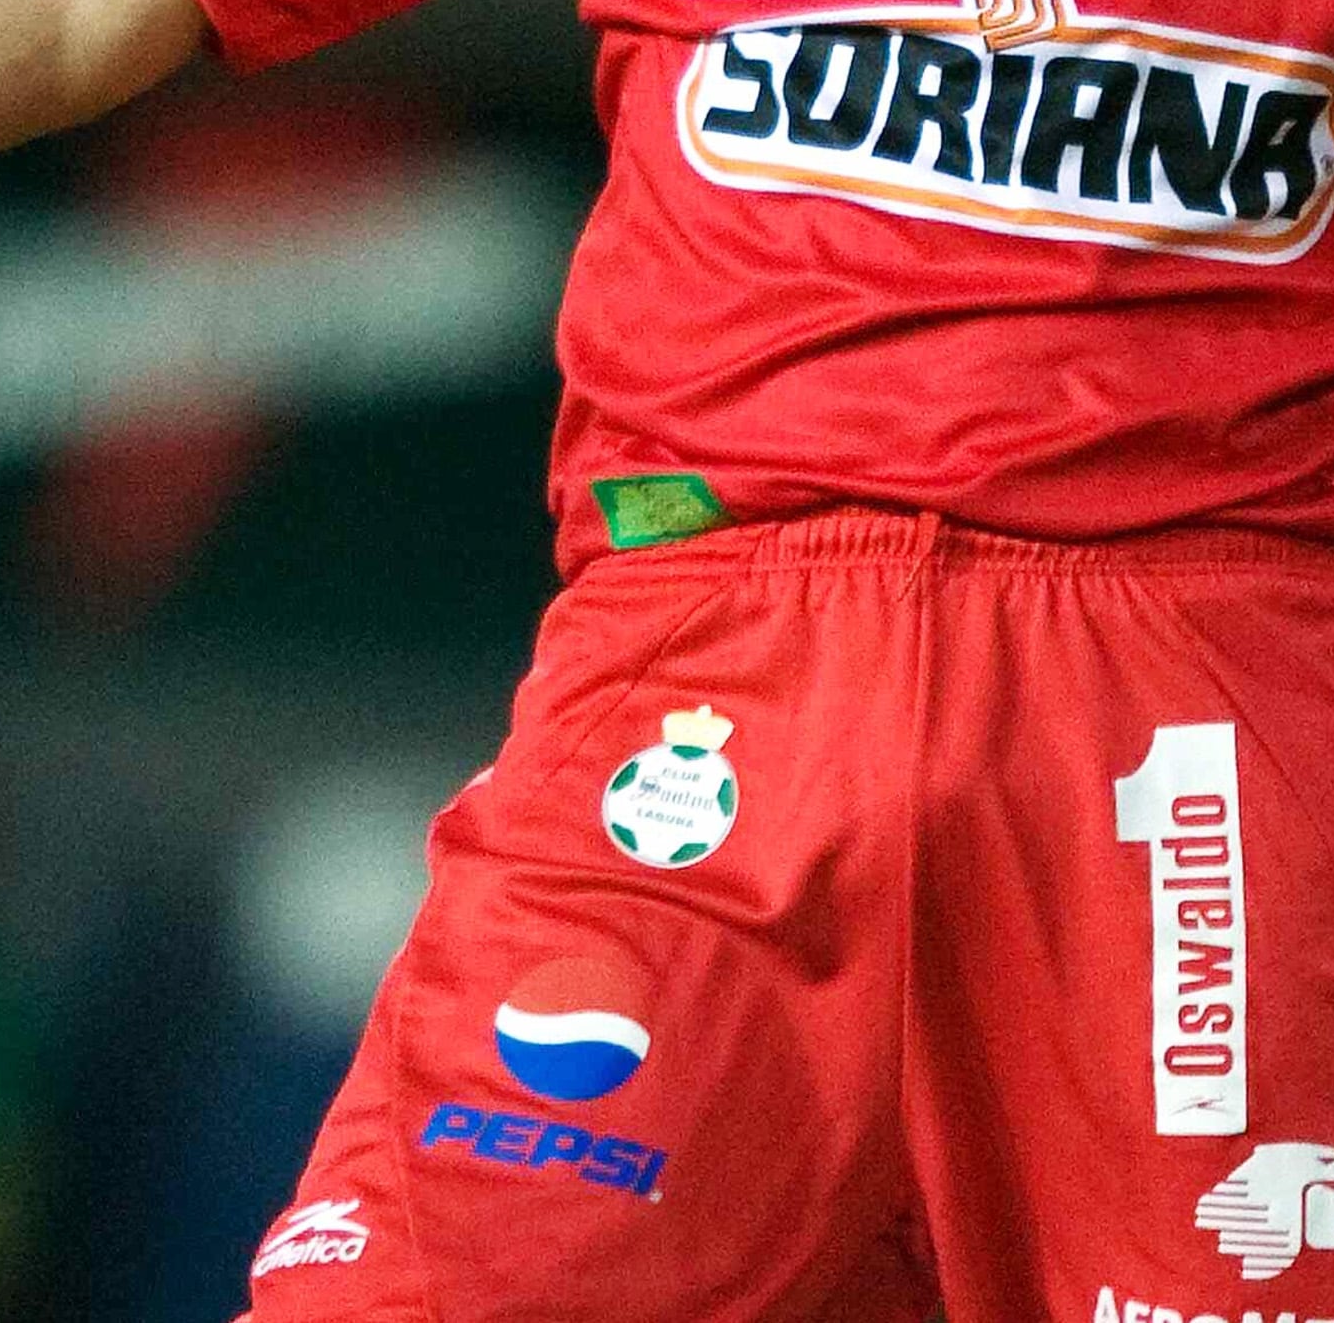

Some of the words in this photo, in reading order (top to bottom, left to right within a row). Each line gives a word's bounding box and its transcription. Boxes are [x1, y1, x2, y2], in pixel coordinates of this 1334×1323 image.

[702, 23, 1331, 222] SORIANA
[1162, 793, 1235, 1078] Oswaldo
[419, 1101, 666, 1195] PEPSI
